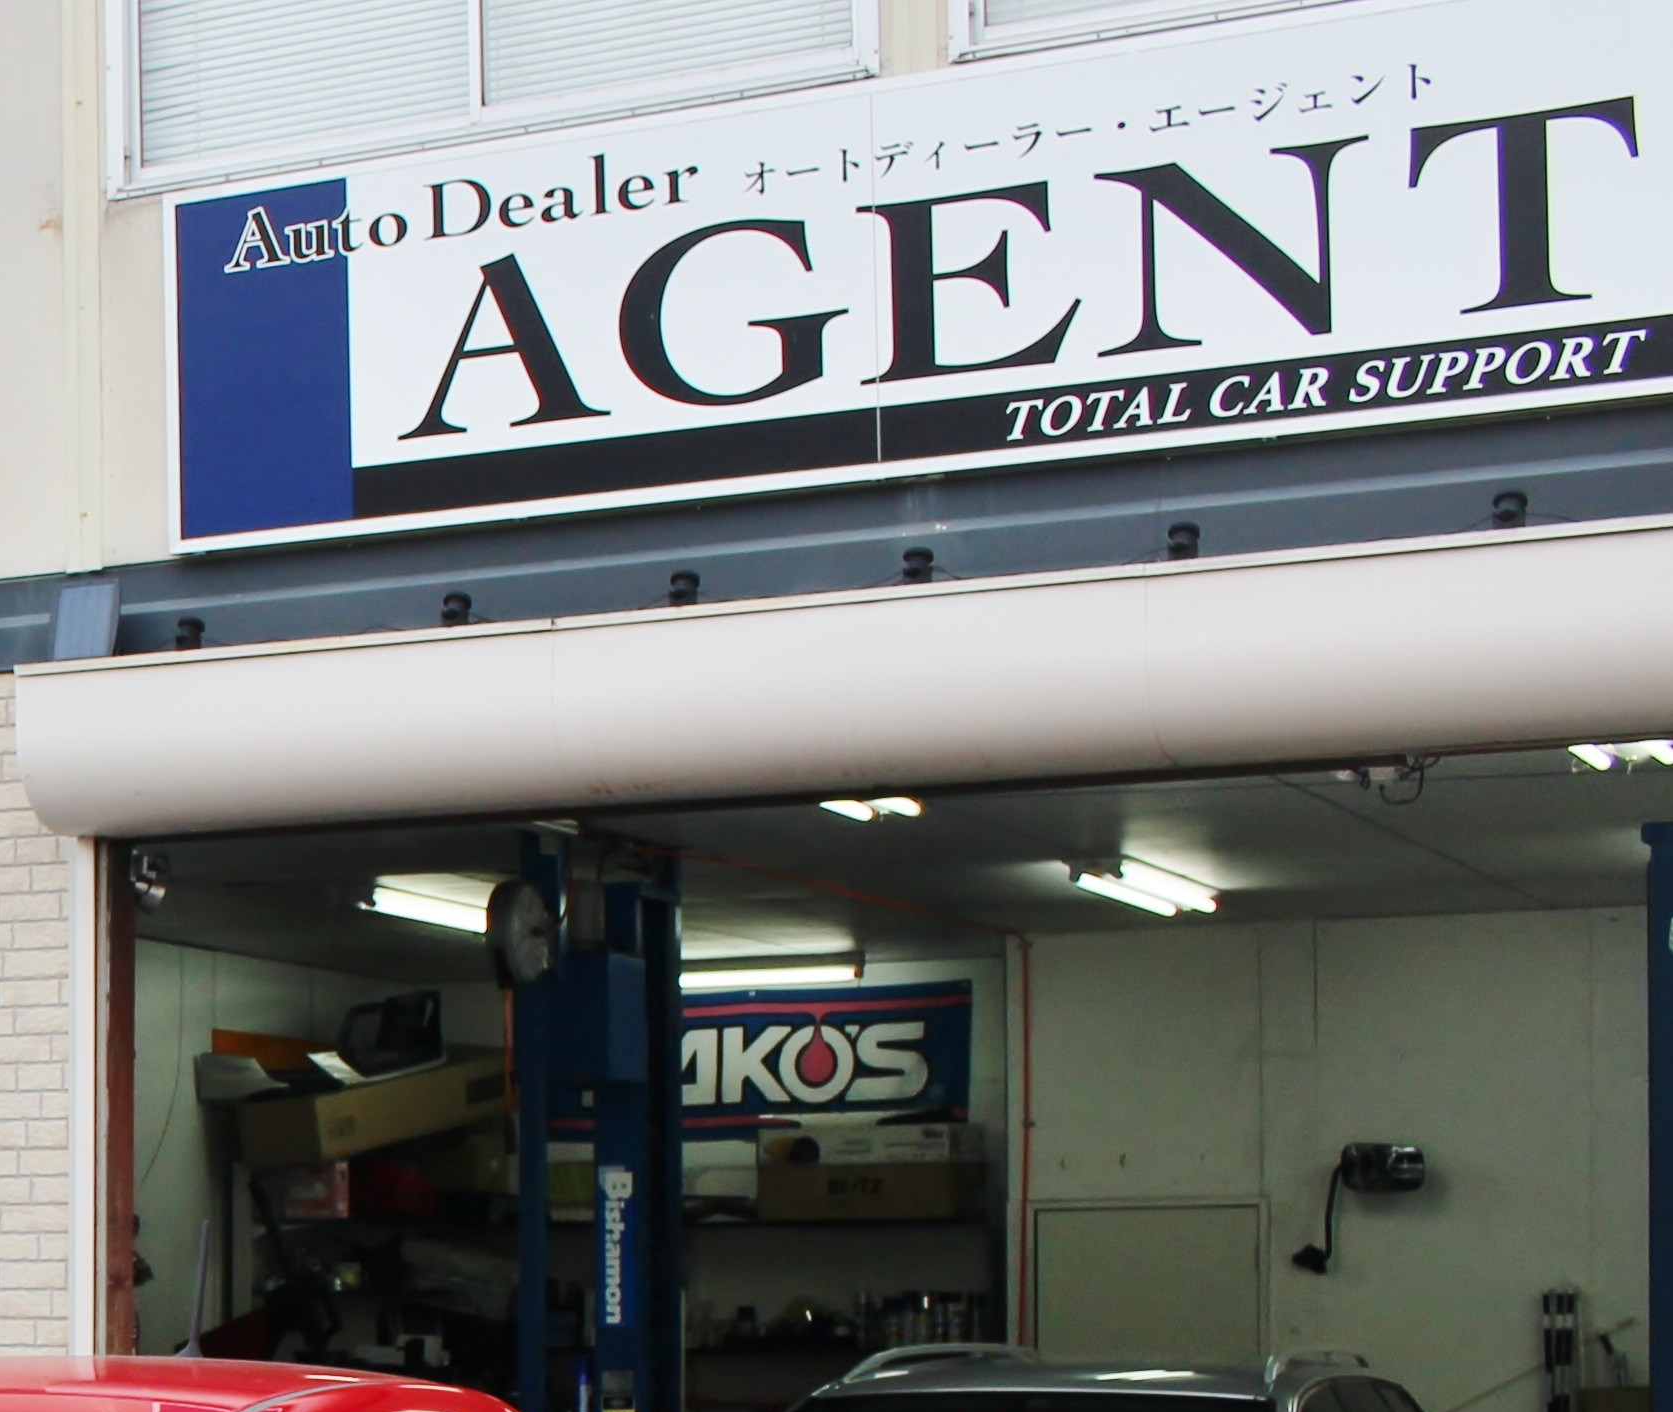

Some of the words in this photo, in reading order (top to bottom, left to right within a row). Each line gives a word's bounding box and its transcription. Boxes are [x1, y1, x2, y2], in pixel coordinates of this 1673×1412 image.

[744, 64, 1433, 194] オートディーラー・エージェント
[225, 204, 408, 274] Auto
[423, 152, 700, 241] Dealer
[396, 96, 1641, 441] AGENT
[1005, 380, 1191, 441] TOTAL
[1209, 367, 1329, 419] CAR
[1348, 329, 1647, 403] SUPPORT
[681, 1020, 928, 1104] AKO'S
